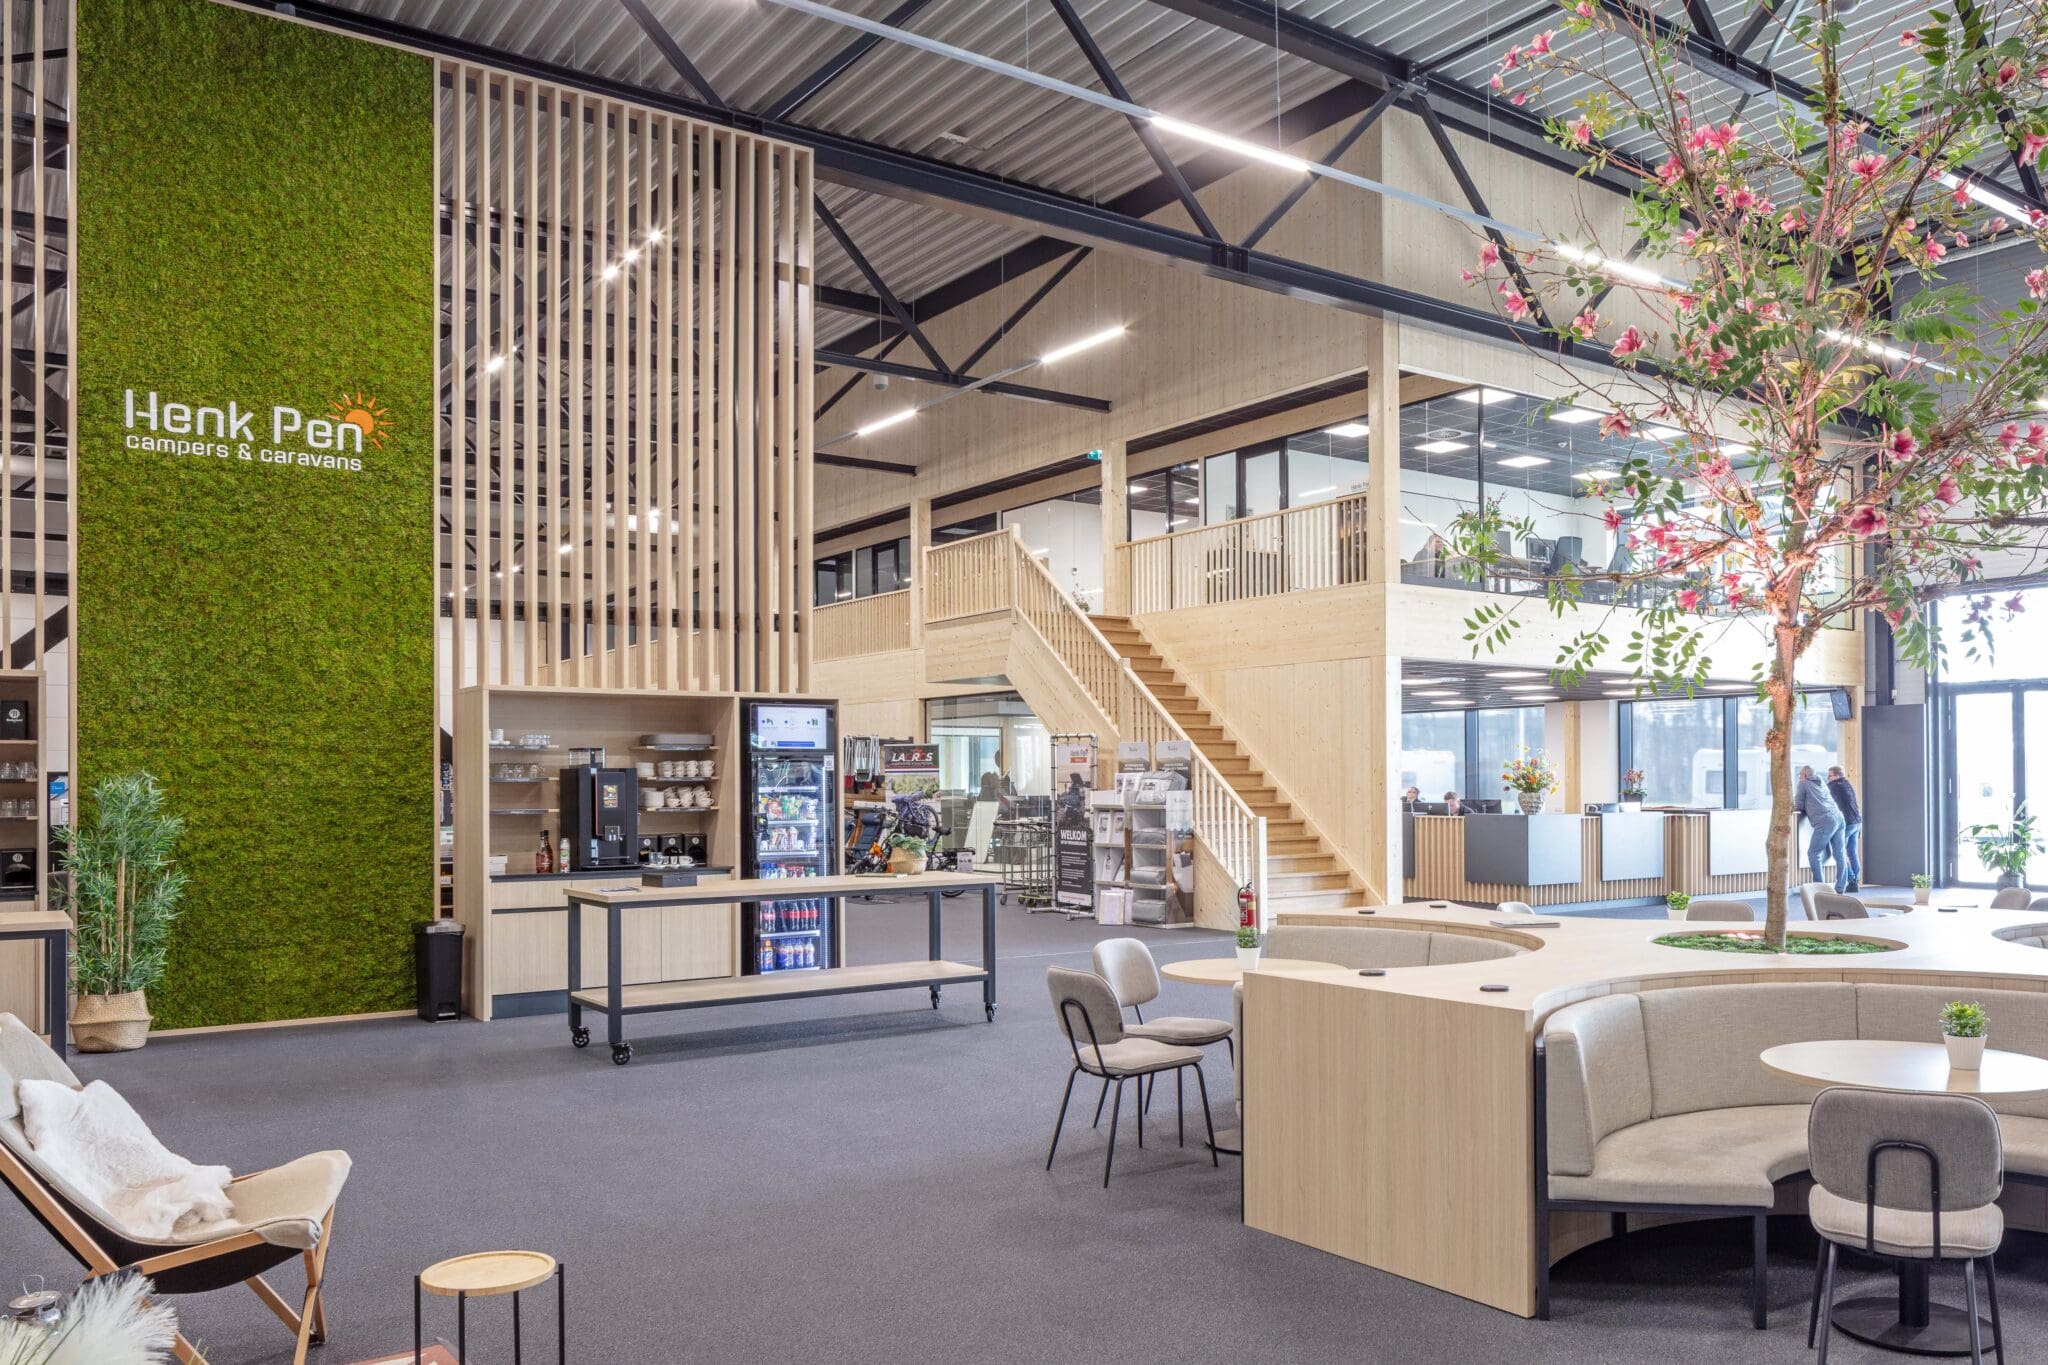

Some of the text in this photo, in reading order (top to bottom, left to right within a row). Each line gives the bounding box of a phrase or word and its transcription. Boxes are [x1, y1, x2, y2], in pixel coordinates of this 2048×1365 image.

[125, 388, 363, 453] Henk Pen
[126, 435, 362, 471] campers & caravans
[1060, 829, 1087, 841] WELKOM
